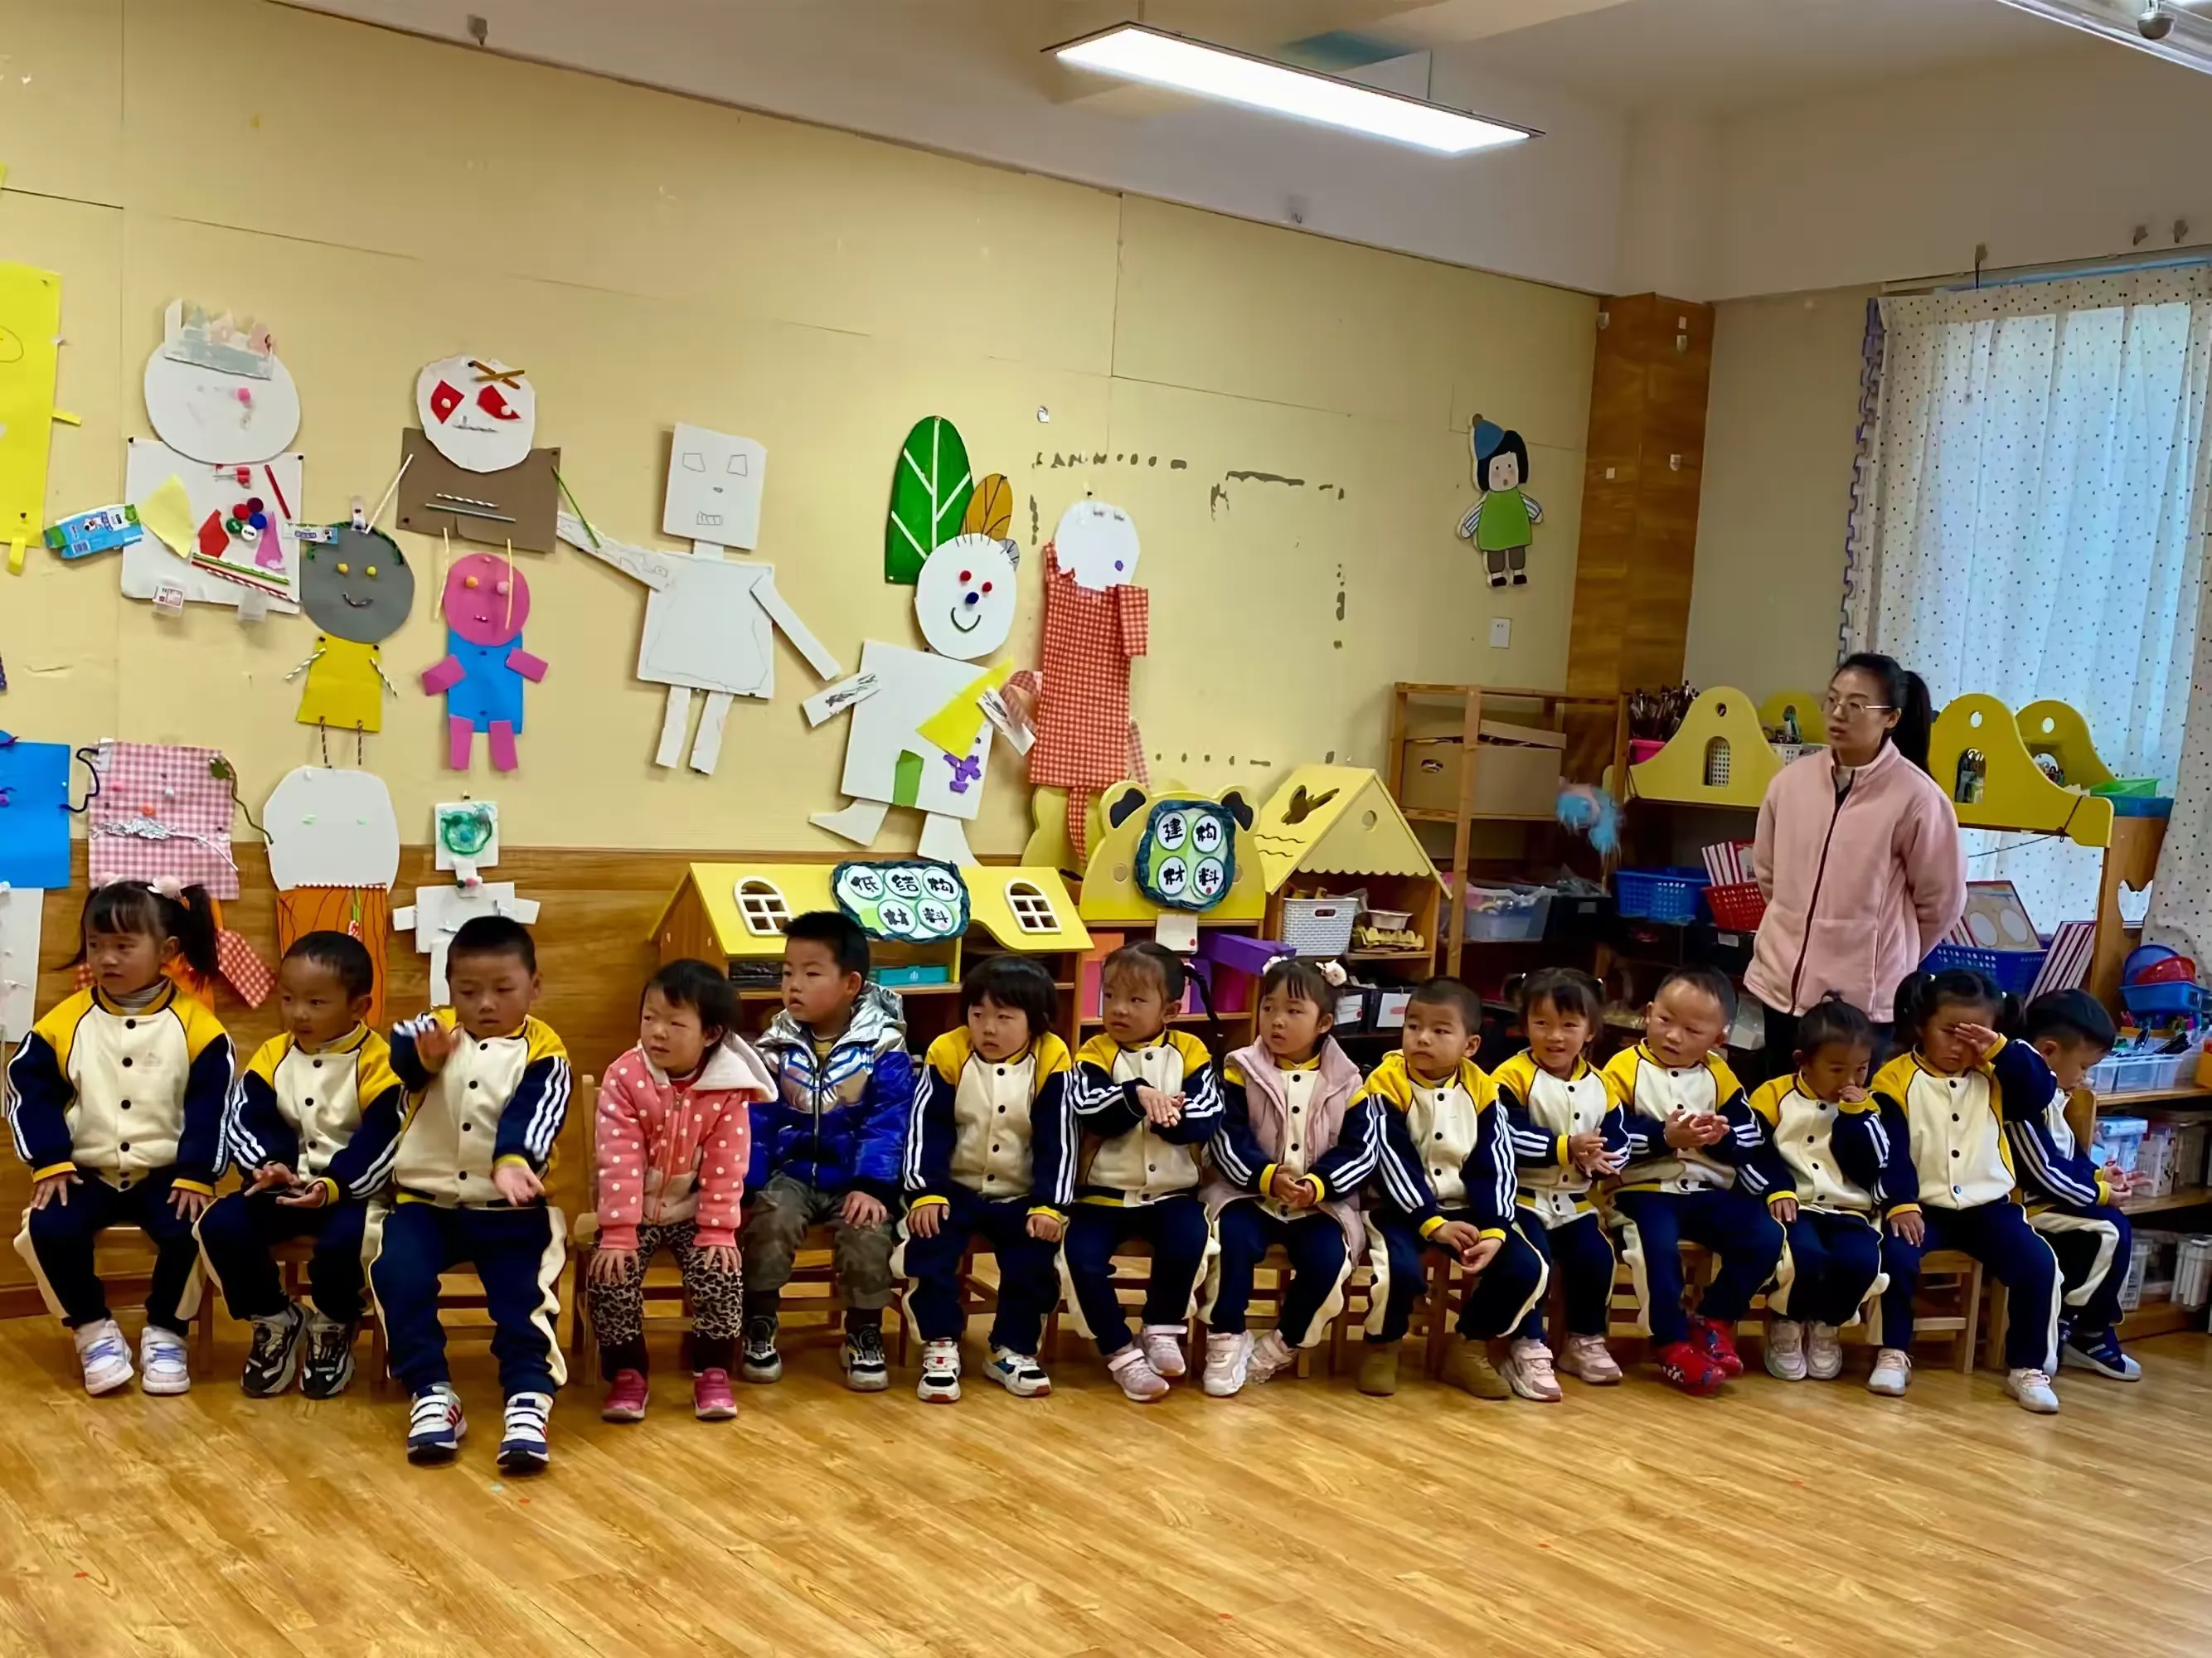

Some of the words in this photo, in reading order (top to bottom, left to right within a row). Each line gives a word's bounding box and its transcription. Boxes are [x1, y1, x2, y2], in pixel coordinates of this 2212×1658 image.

[1162, 817, 1217, 843] 建构
[1163, 865, 1220, 886] 材料
[883, 907, 948, 926] 材料
